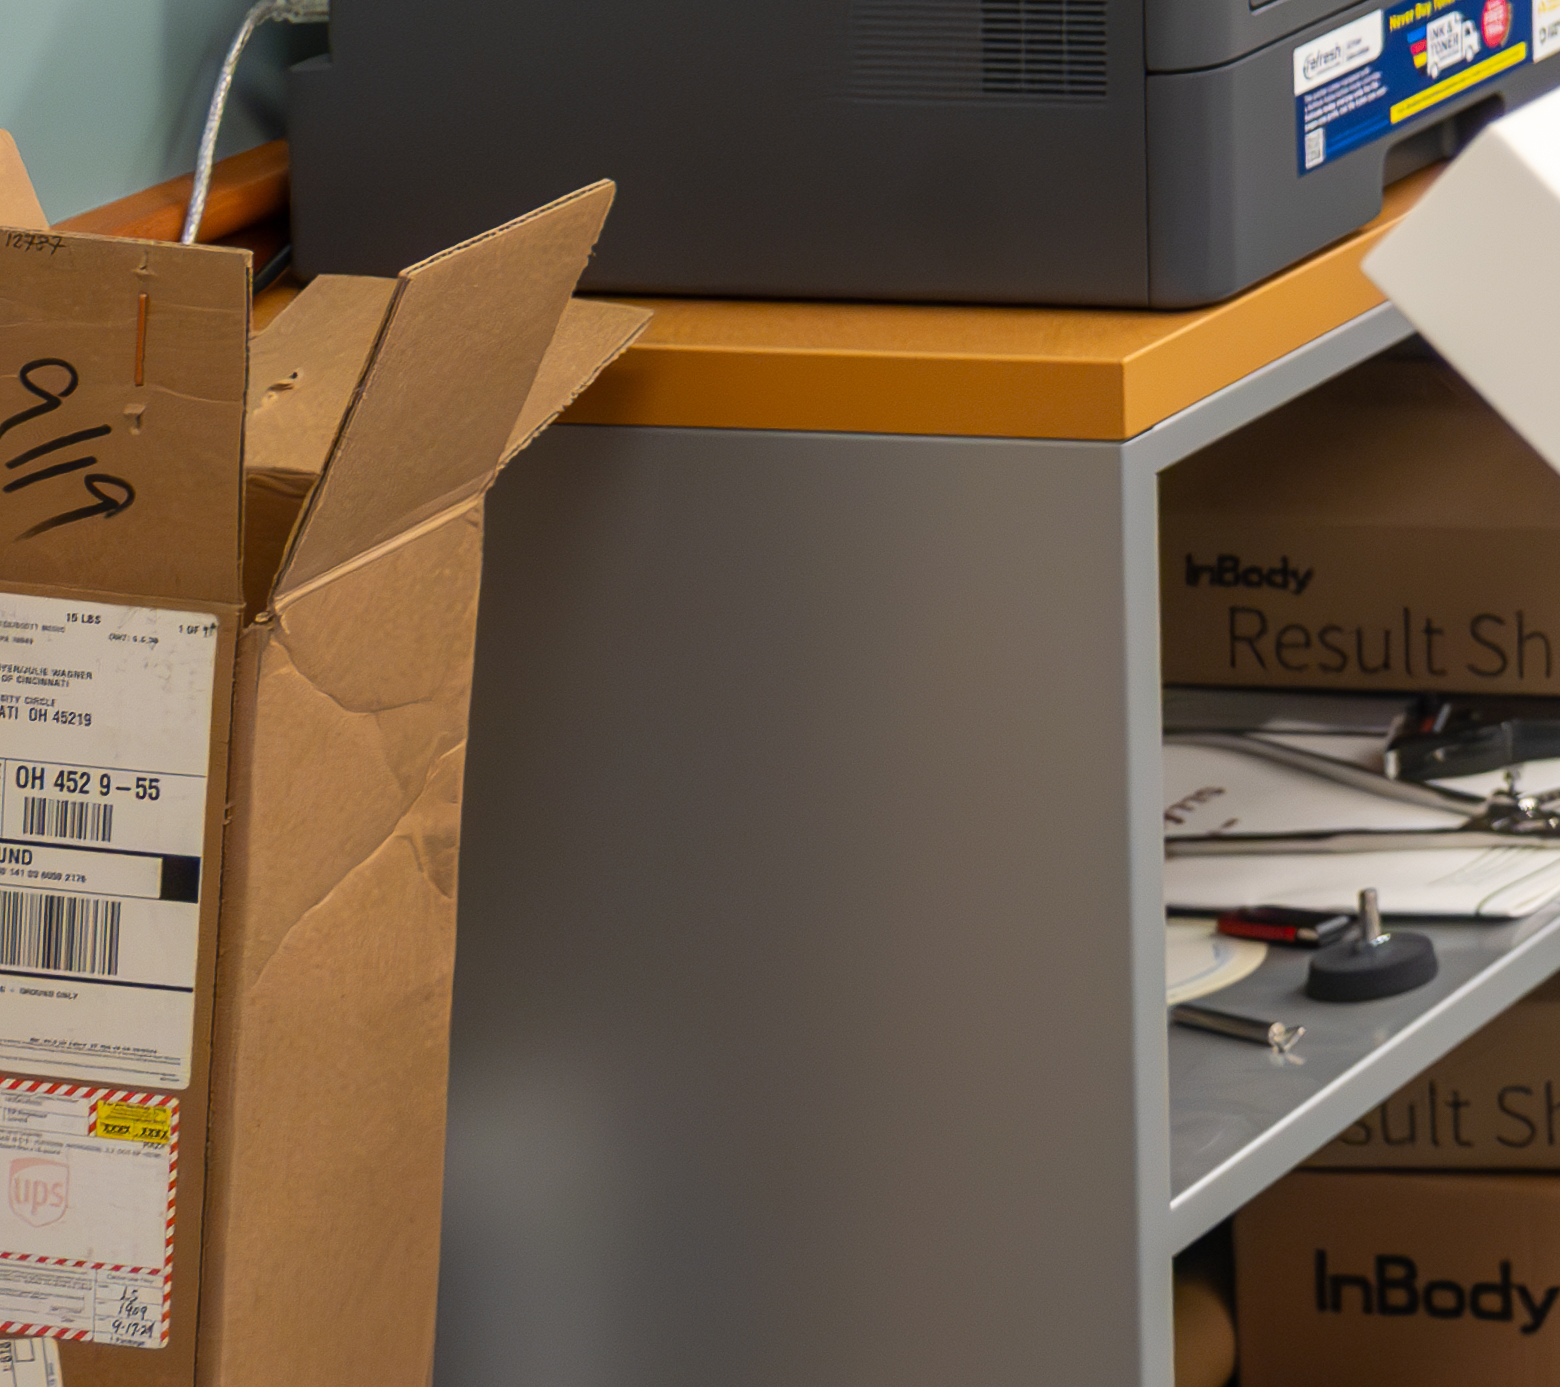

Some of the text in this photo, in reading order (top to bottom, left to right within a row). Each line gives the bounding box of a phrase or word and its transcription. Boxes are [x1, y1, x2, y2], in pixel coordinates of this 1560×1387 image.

[1389, 10, 1414, 31] Never
[1415, 0, 1432, 21] Buy
[1430, 25, 1445, 39] INK
[1430, 33, 1459, 56] TONER
[1185, 553, 1313, 594] InBody
[81, 613, 101, 625] LBS
[1228, 605, 1447, 677] Result
[16, 674, 70, 688] CINCINNATI
[51, 669, 93, 681] WAGNER
[28, 707, 48, 723] OH
[52, 710, 92, 727] 45219
[16, 765, 45, 791] OH
[54, 769, 91, 795] 452
[14, 1177, 64, 1215] ups
[1315, 1248, 1560, 1336] InBody
